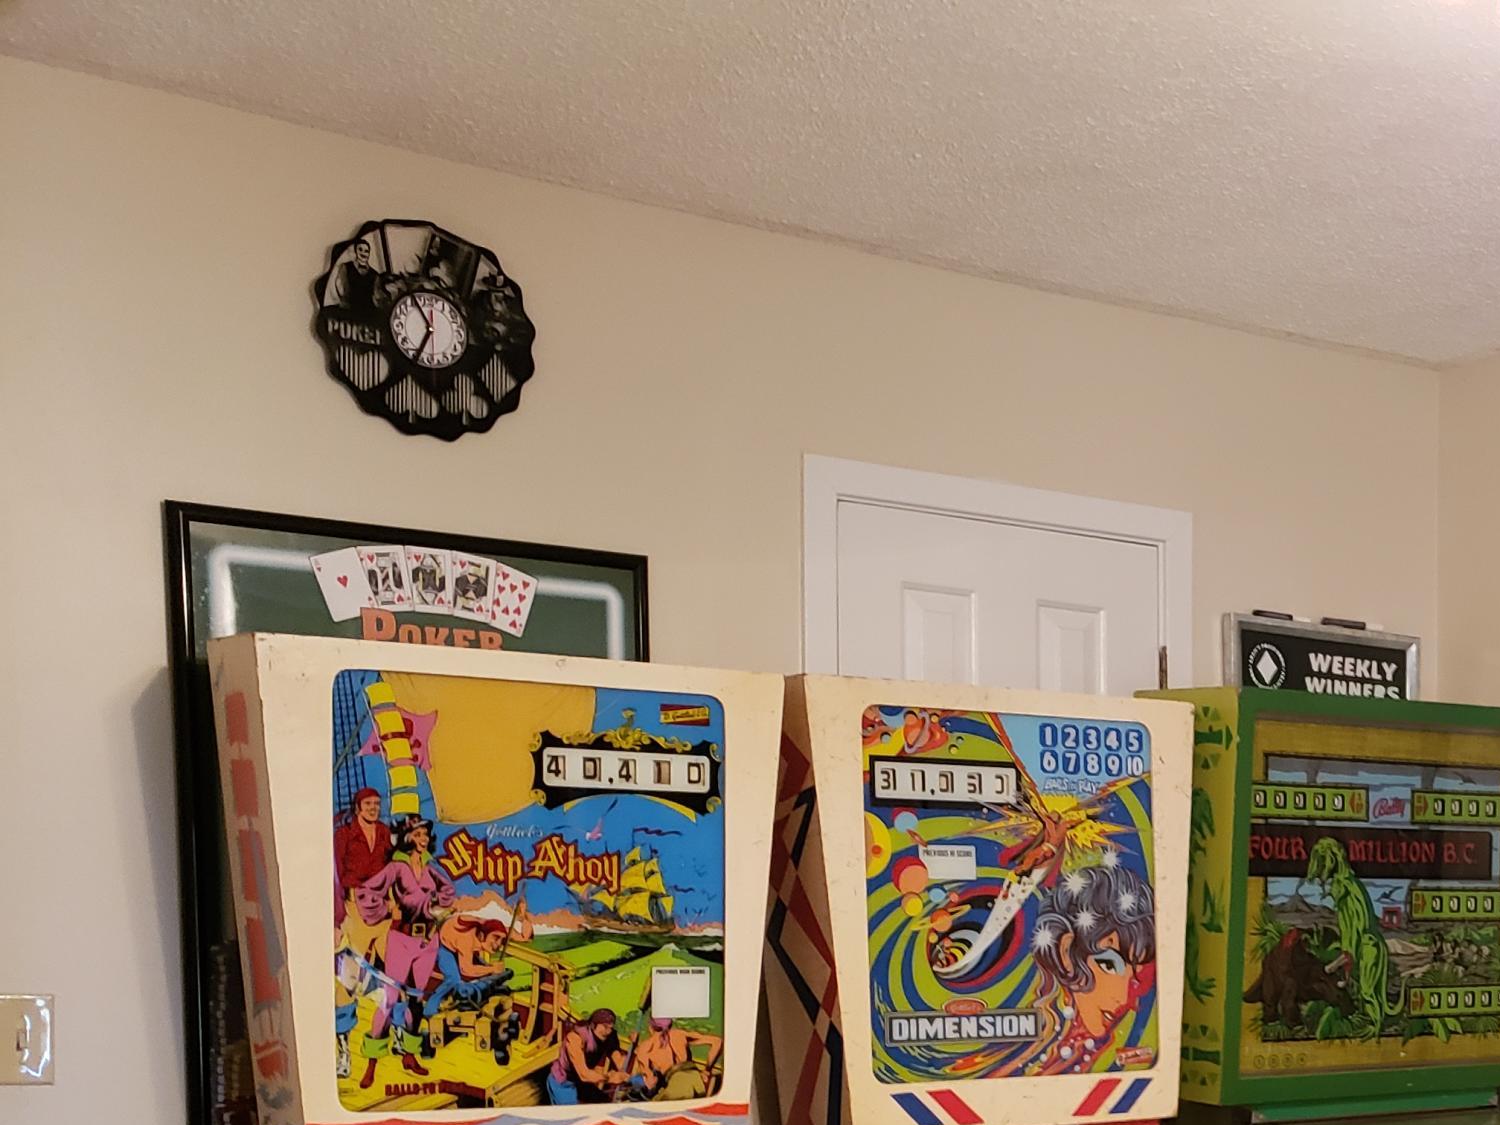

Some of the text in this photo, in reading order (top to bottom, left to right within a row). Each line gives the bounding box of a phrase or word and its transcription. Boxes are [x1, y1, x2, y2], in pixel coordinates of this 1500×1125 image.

[360, 606, 504, 651] POKER
[1308, 652, 1398, 682] WEEKLY
[1304, 676, 1400, 701] WINNERS
[1044, 726, 1140, 752] 1 2 3 4 5
[1042, 751, 1143, 776] 6 7 8 9 10
[438, 830, 619, 895] Ship Ahoy
[1250, 835, 1308, 862] FOUR
[1350, 839, 1435, 865] MILLION
[891, 1014, 1036, 1042] DIMENSION
